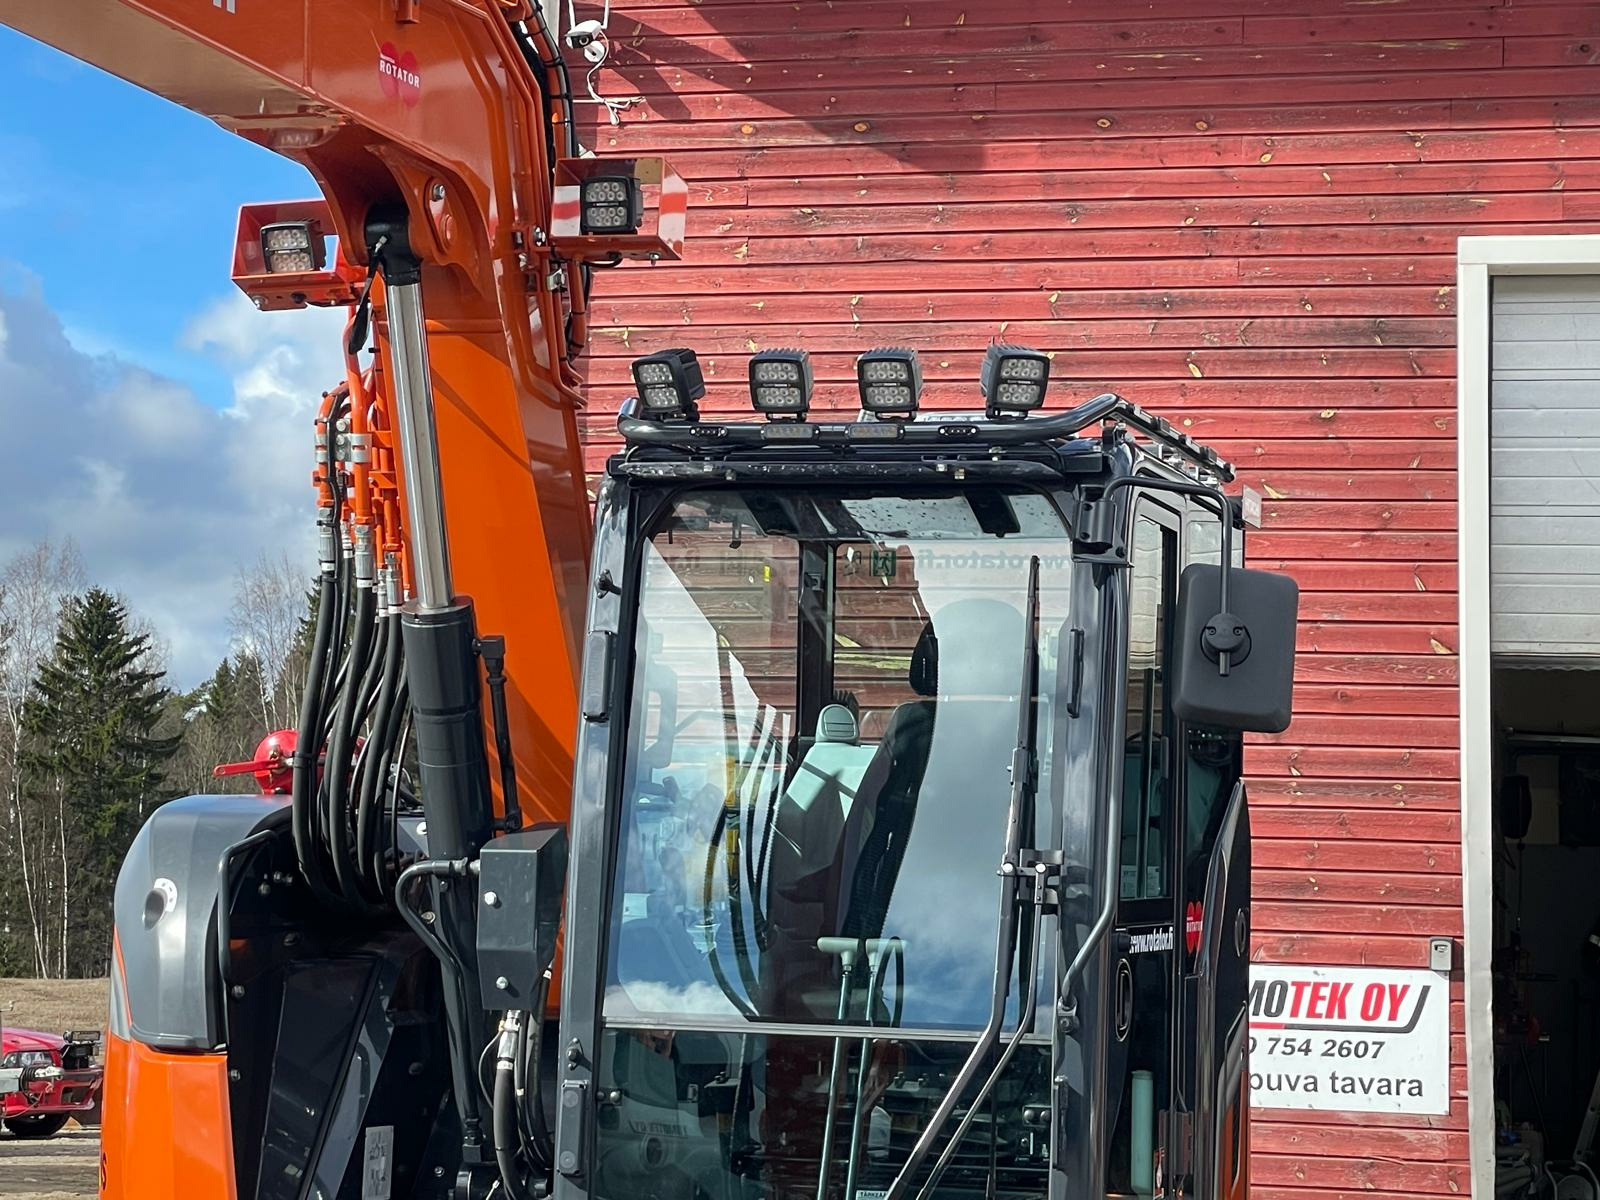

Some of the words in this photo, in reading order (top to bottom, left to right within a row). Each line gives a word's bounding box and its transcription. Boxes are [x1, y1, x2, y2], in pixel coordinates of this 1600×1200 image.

[380, 59, 420, 88] ROTATOR
[1360, 982, 1410, 1021] OY
[1267, 1037, 1312, 1056] 754
[1320, 1039, 1386, 1059] 2607
[1329, 1071, 1423, 1097] tavara
